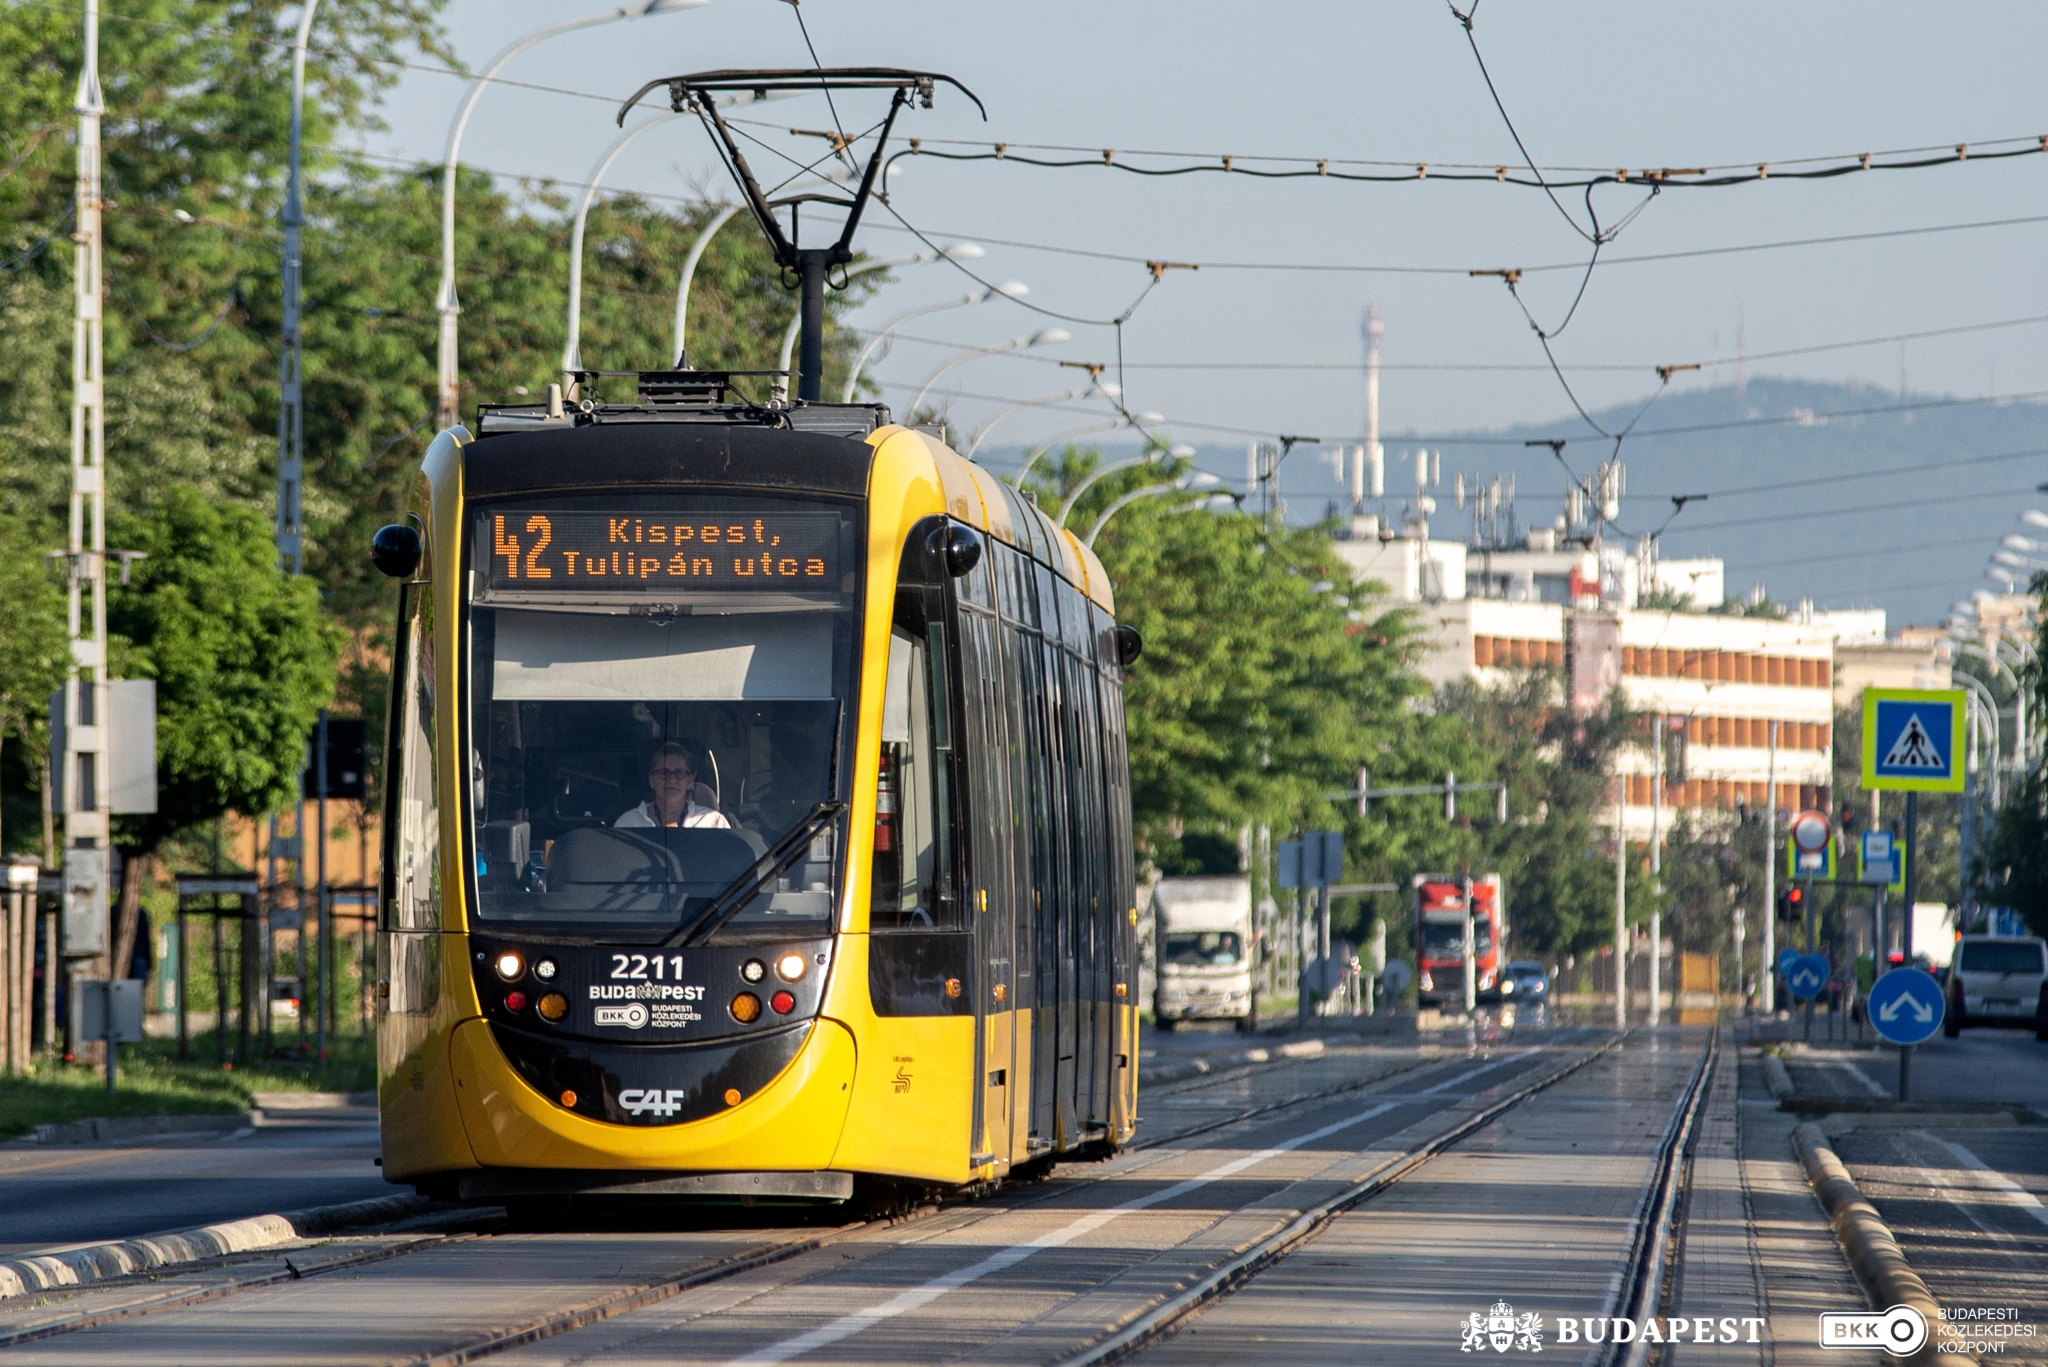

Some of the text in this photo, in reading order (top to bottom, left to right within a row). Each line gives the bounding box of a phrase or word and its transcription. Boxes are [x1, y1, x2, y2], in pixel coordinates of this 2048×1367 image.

[609, 518, 780, 547] Kispest,
[495, 515, 552, 579] 42
[563, 551, 825, 579] Tulipán utca
[610, 955, 683, 980] 2211
[602, 1011, 625, 1020] BKK
[651, 1004, 693, 1012] BUDAPESTI
[651, 1012, 701, 1020] KÖZLEKEDÉSI
[651, 1020, 687, 1028] KÖZPONT
[618, 1089, 684, 1117] CAF
